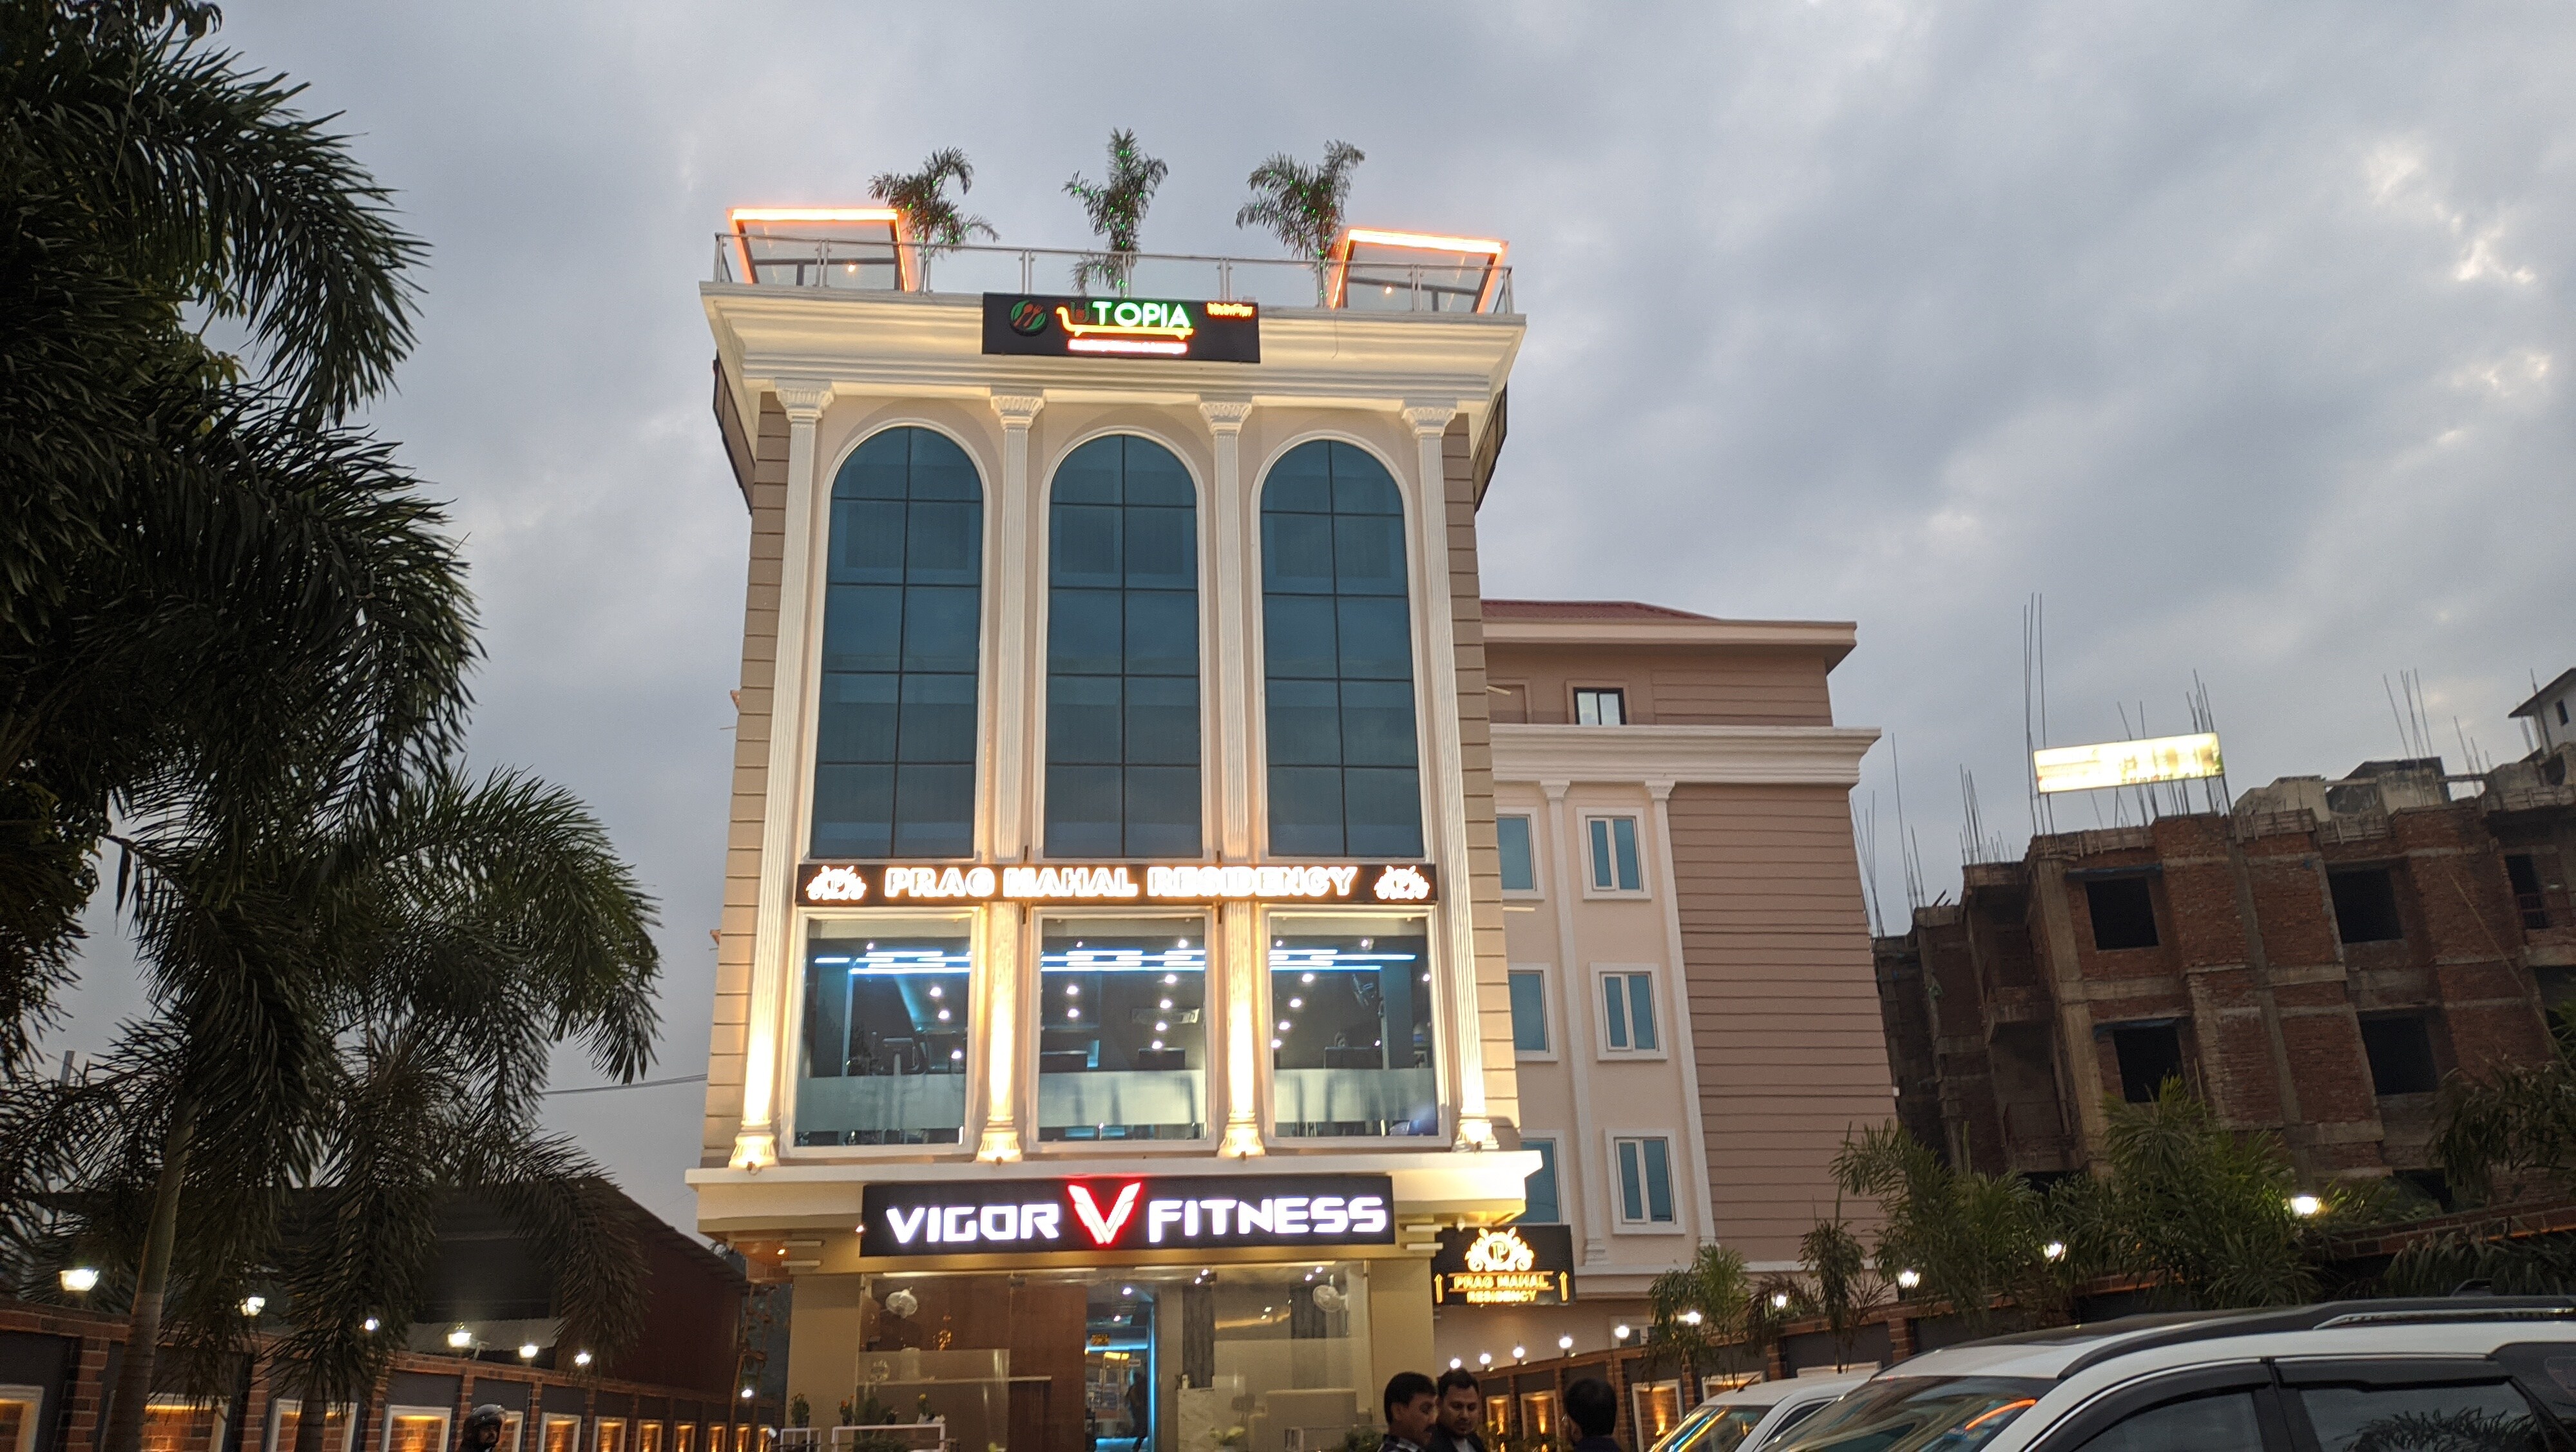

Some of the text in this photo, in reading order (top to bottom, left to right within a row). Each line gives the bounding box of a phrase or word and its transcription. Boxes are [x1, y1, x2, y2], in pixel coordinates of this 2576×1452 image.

[1070, 301, 1191, 329] UTOPIA
[883, 866, 1358, 897] PRAG MAHAL RESIDENCY
[886, 1203, 1059, 1243] VIGOR
[1148, 1197, 1387, 1243] FITNESS
[1454, 1274, 1549, 1289] PRAG MAHAL
